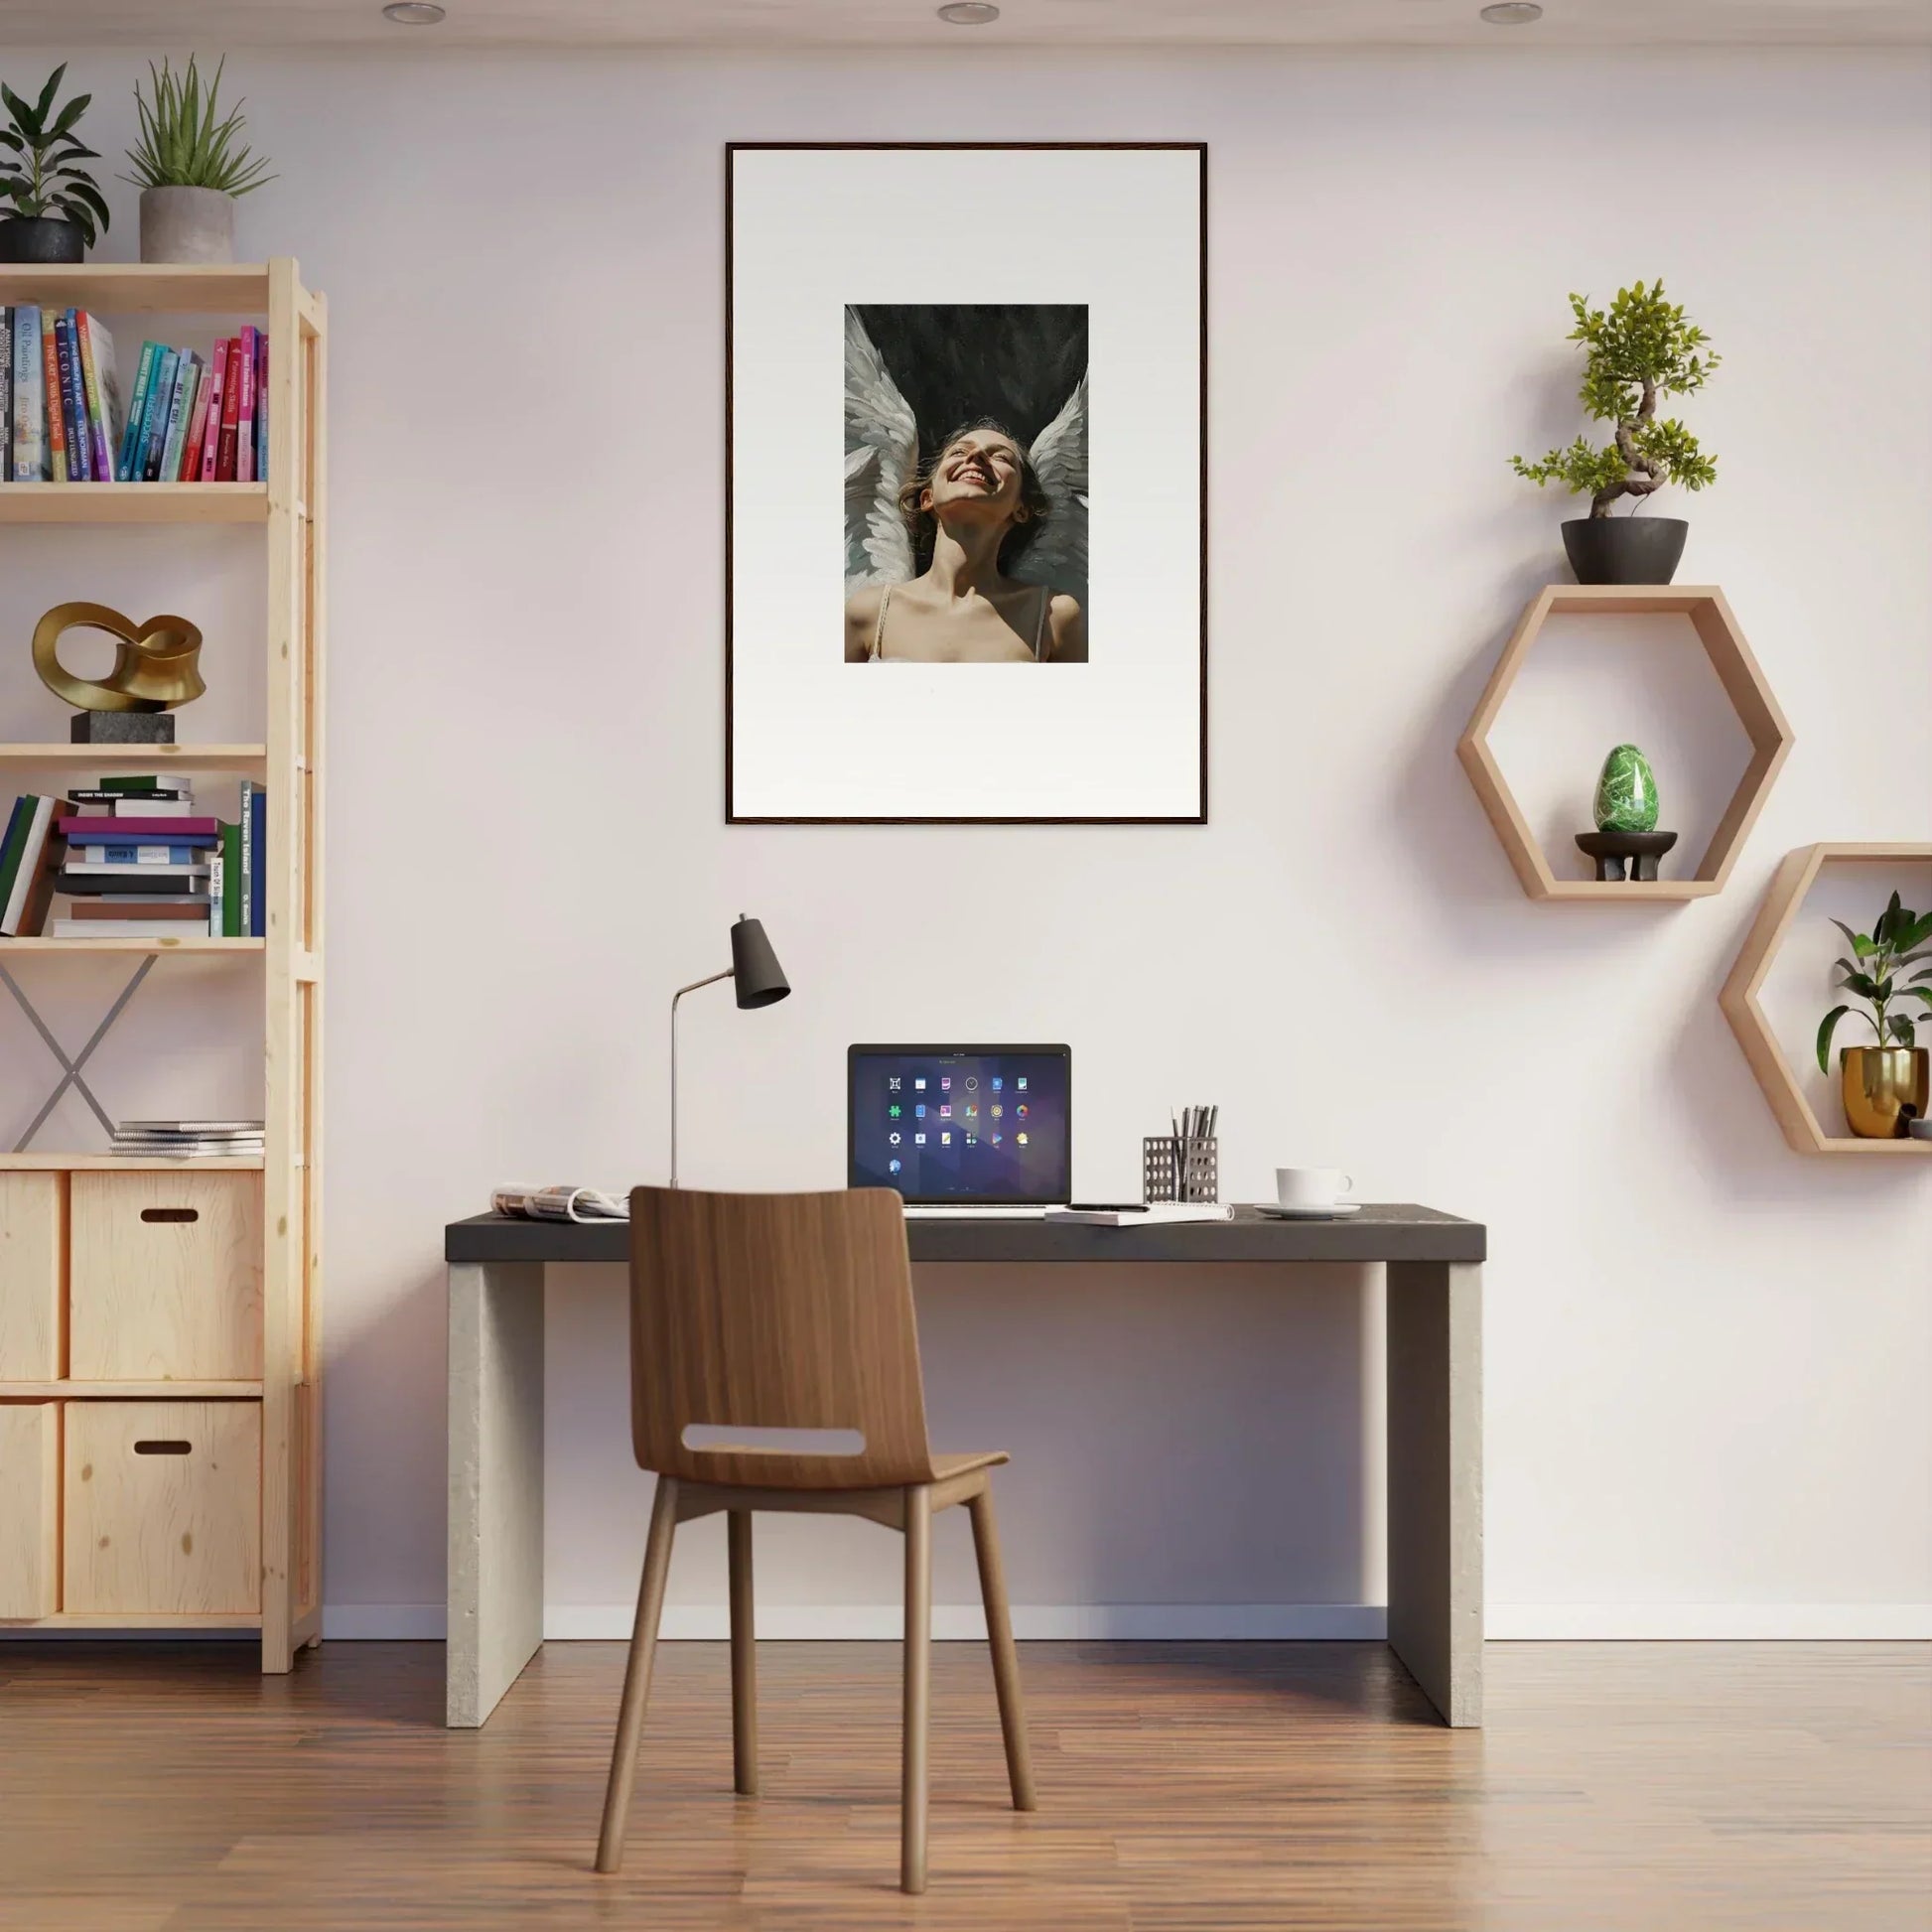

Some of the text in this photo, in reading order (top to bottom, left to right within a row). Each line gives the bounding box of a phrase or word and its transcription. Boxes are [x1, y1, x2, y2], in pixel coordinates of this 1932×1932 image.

[18, 340, 32, 382] Paintings
[59, 342, 72, 406] ICONIC
[49, 381, 60, 398] With
[49, 400, 61, 421] Digital
